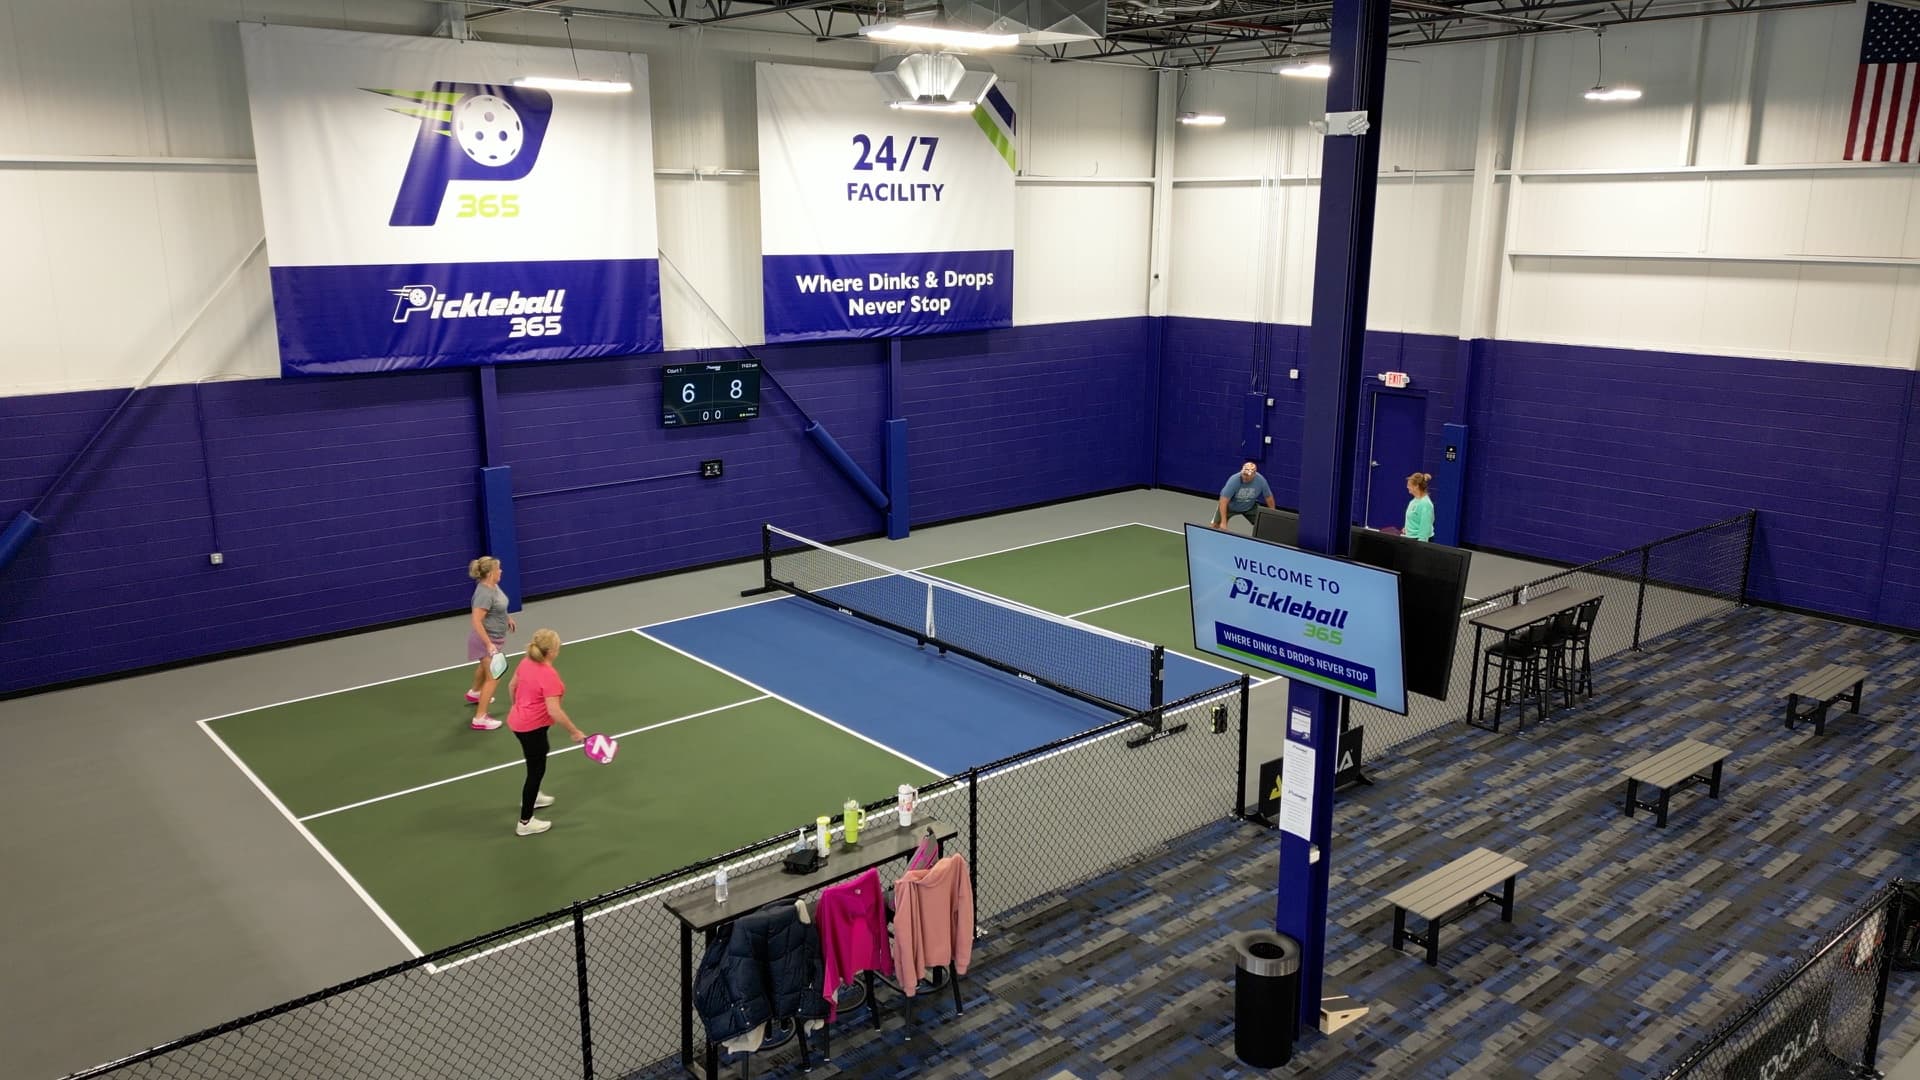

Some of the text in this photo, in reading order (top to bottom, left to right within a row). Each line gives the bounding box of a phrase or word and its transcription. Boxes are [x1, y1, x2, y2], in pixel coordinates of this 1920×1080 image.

[852, 133, 939, 172] 24/7
[847, 182, 945, 202] FACILITY
[456, 194, 520, 218] 365
[795, 270, 994, 293] Where Dinks & Drops
[392, 284, 565, 323] Pickleball
[848, 295, 951, 316] Never Stop
[508, 315, 563, 338] 365
[730, 379, 742, 399] 8
[1388, 373, 1403, 385] EXIT
[682, 383, 695, 403] 6
[702, 410, 721, 421] 0 0
[1233, 555, 1340, 594] WELCOME TO
[1229, 576, 1349, 630] Pickleball
[1303, 623, 1344, 646] 365
[1223, 629, 1369, 683] WHERE DINKS & DROPS NEVER STOP
